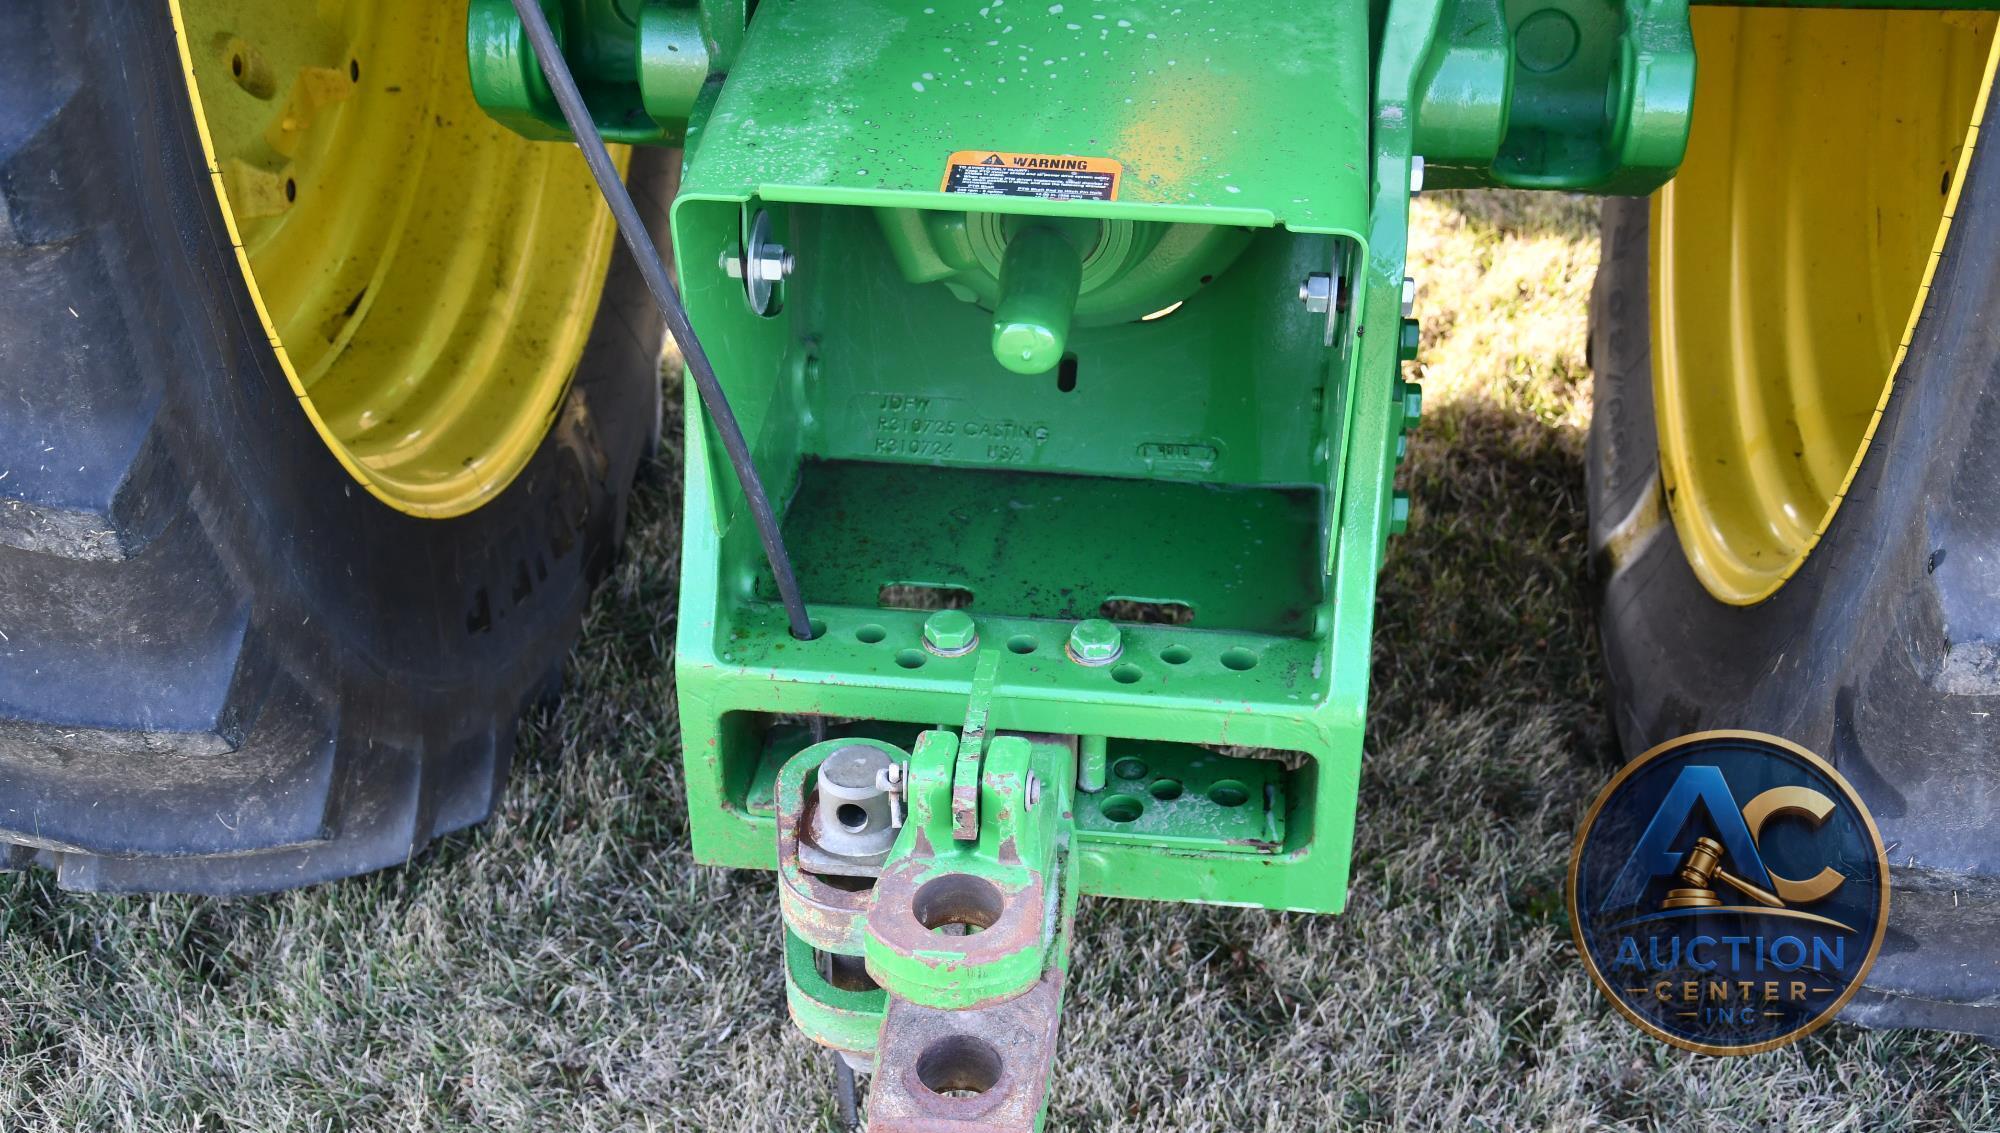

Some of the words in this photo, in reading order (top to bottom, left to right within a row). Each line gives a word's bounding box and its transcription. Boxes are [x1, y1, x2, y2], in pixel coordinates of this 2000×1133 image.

[1013, 157, 1088, 170] WARNING
[963, 421, 1049, 444] CASTING
[987, 444, 1024, 462] USA
